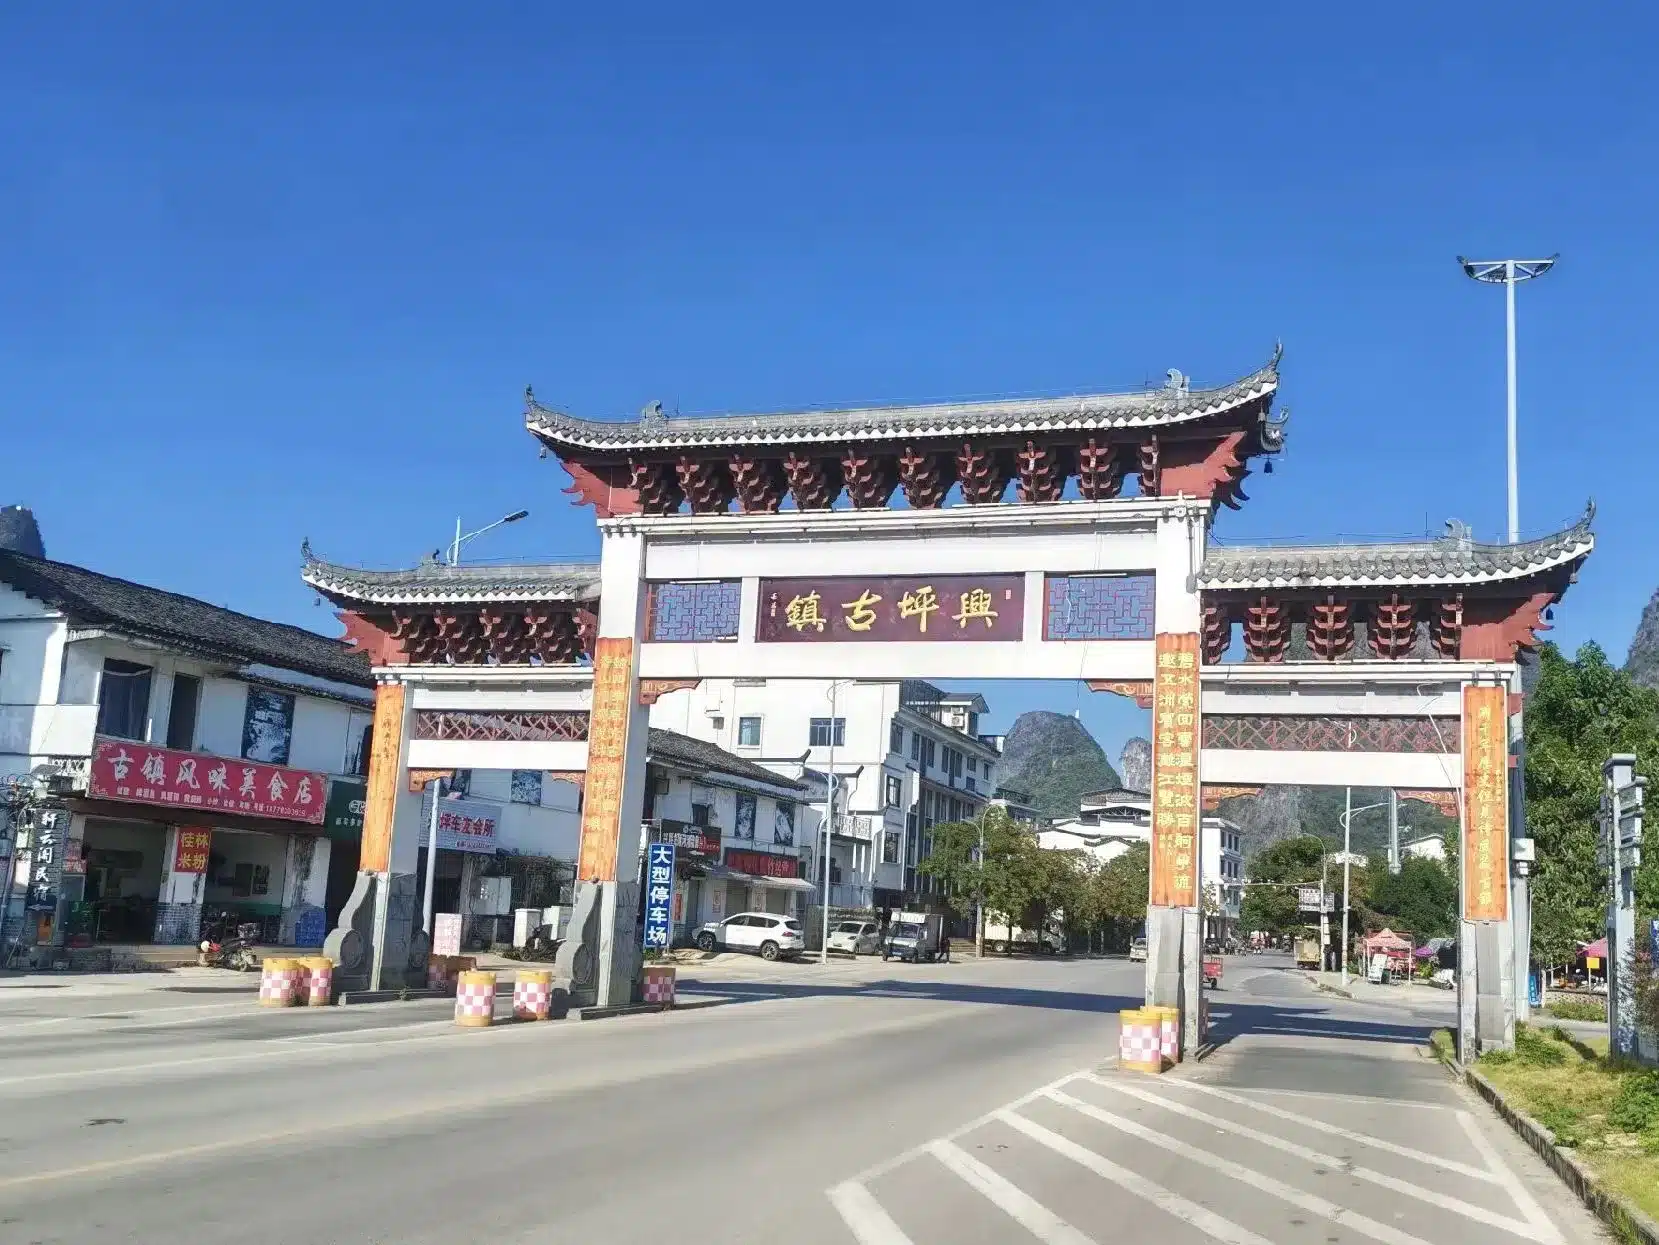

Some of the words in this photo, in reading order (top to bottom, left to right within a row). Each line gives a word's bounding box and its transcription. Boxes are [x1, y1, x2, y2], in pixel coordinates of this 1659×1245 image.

[108, 748, 312, 804] 古镇风味美食店
[179, 853, 205, 870] 米粉
[648, 846, 672, 944] 大型停车场
